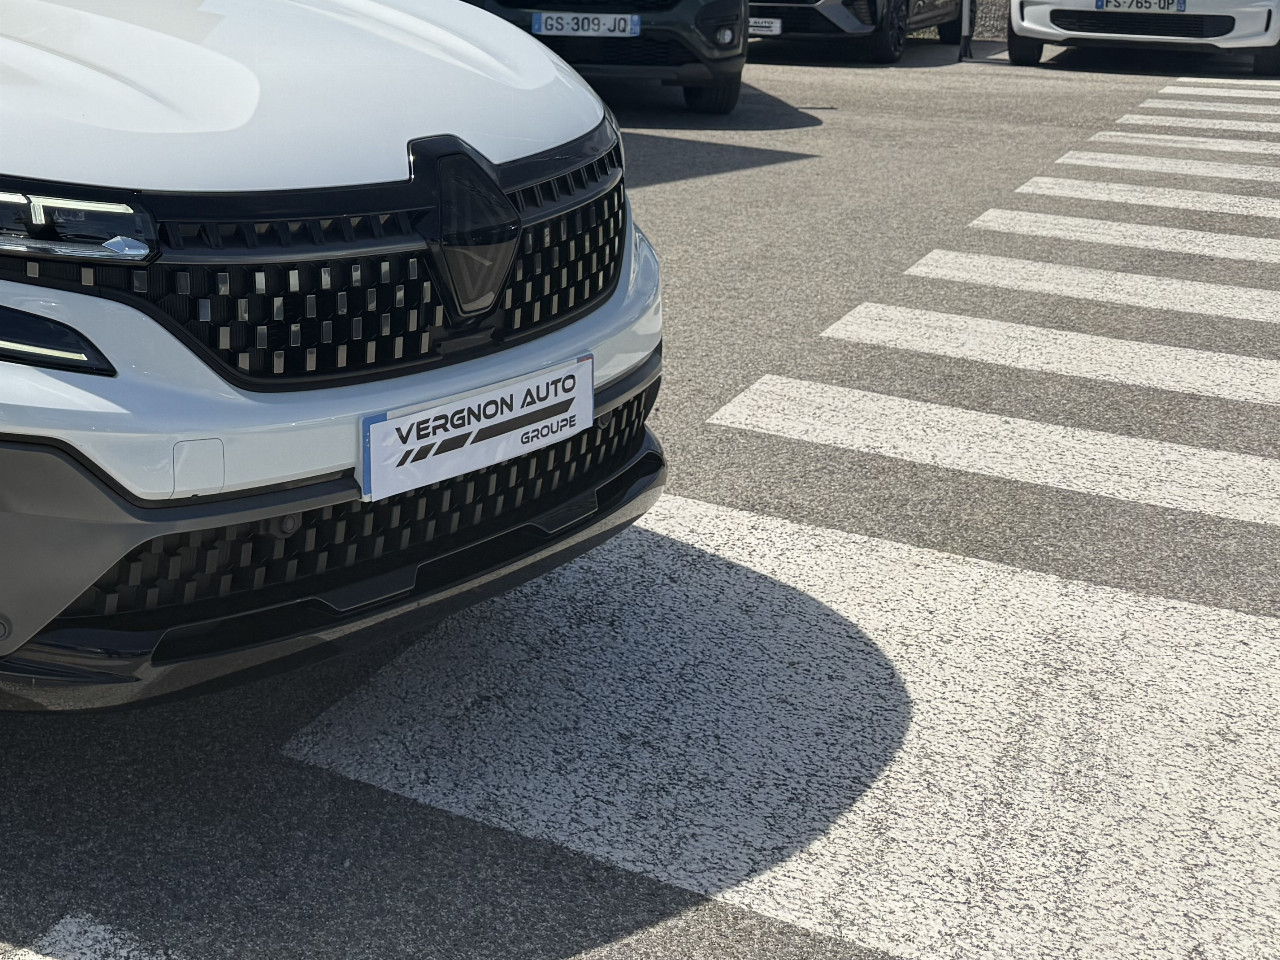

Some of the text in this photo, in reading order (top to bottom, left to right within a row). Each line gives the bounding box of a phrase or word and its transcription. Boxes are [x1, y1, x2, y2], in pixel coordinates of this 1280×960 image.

[544, 16, 627, 33] GS-309-JQ
[395, 374, 576, 445] VERGNON AUTO
[521, 414, 577, 445] GROUPE
